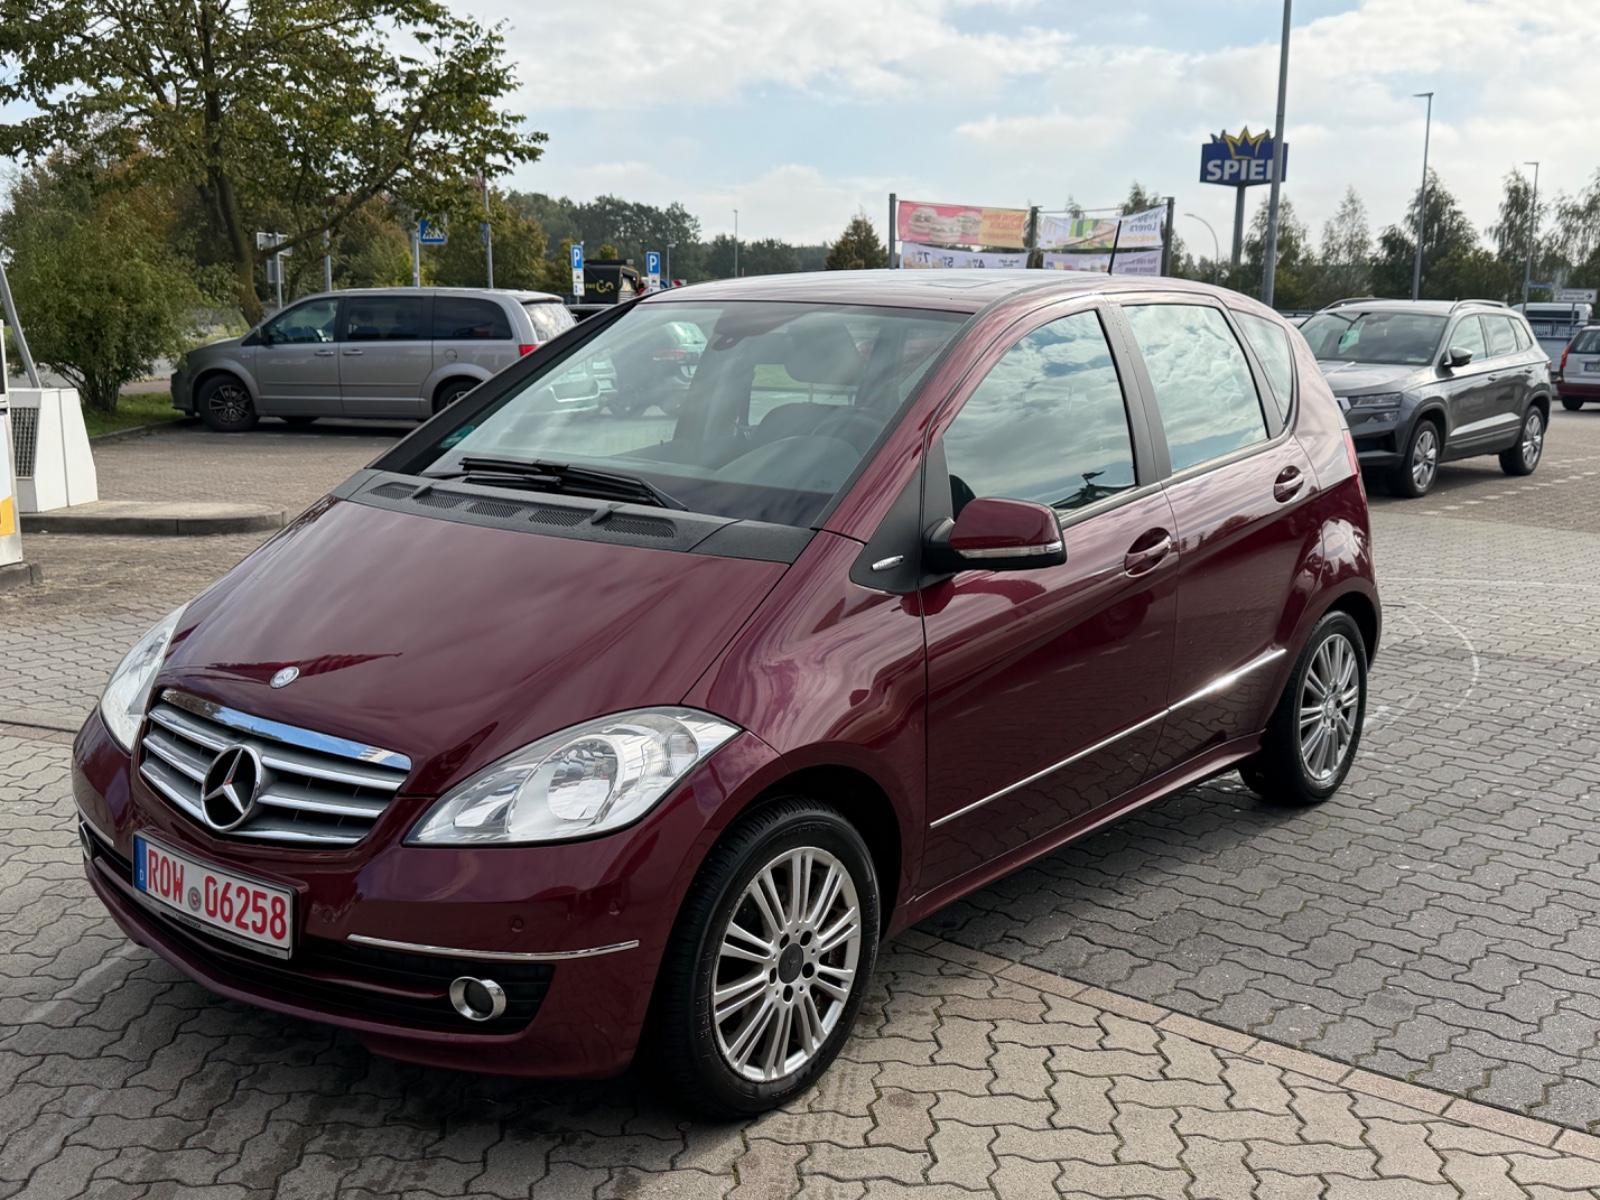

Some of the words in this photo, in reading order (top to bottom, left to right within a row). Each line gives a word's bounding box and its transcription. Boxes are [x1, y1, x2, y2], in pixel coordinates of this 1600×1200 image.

[573, 248, 581, 267] P
[649, 255, 658, 272] P
[148, 849, 184, 904] ROW
[204, 875, 287, 940] 06258
